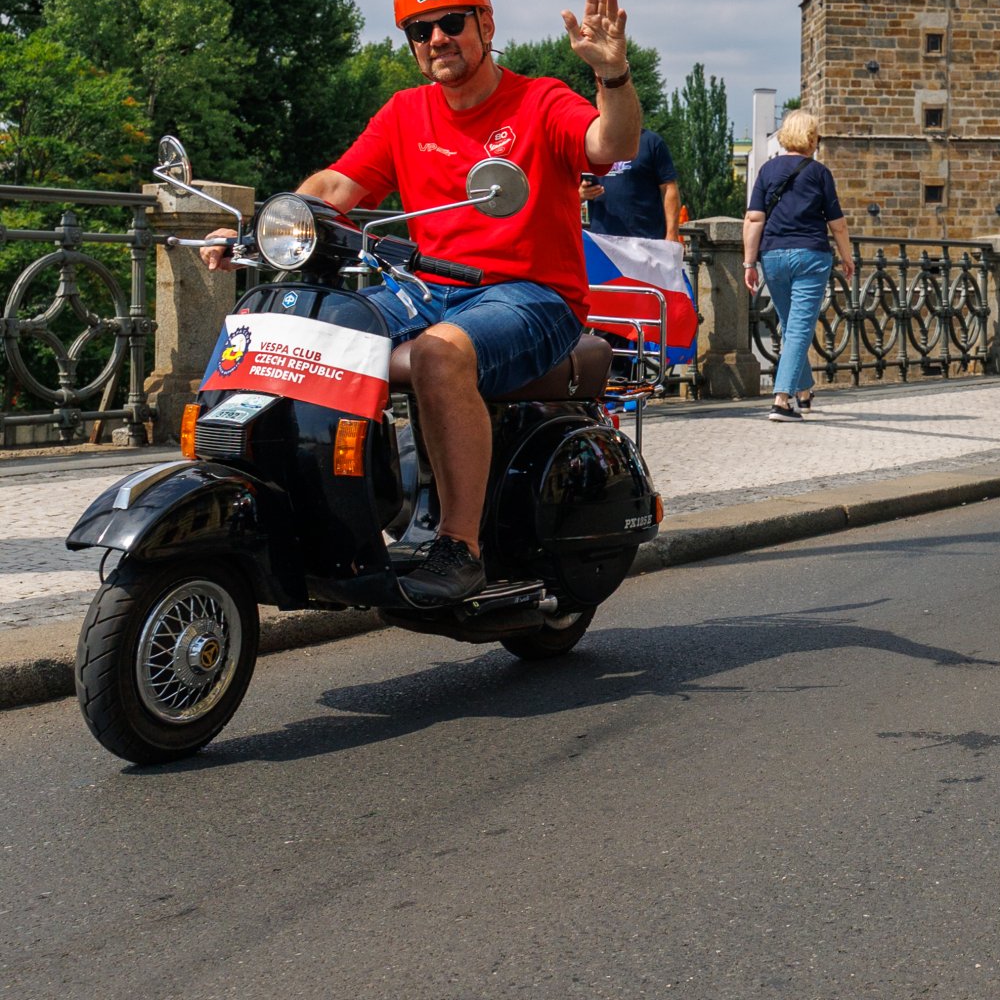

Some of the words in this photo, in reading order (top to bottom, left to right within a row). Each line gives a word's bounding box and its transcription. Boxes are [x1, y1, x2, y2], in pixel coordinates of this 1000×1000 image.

[260, 341, 289, 355] VESPA
[292, 347, 322, 362] CLUB
[249, 365, 305, 384] PRESIDENT
[254, 353, 286, 367] CZECH
[288, 359, 344, 381] REPUBLIC
